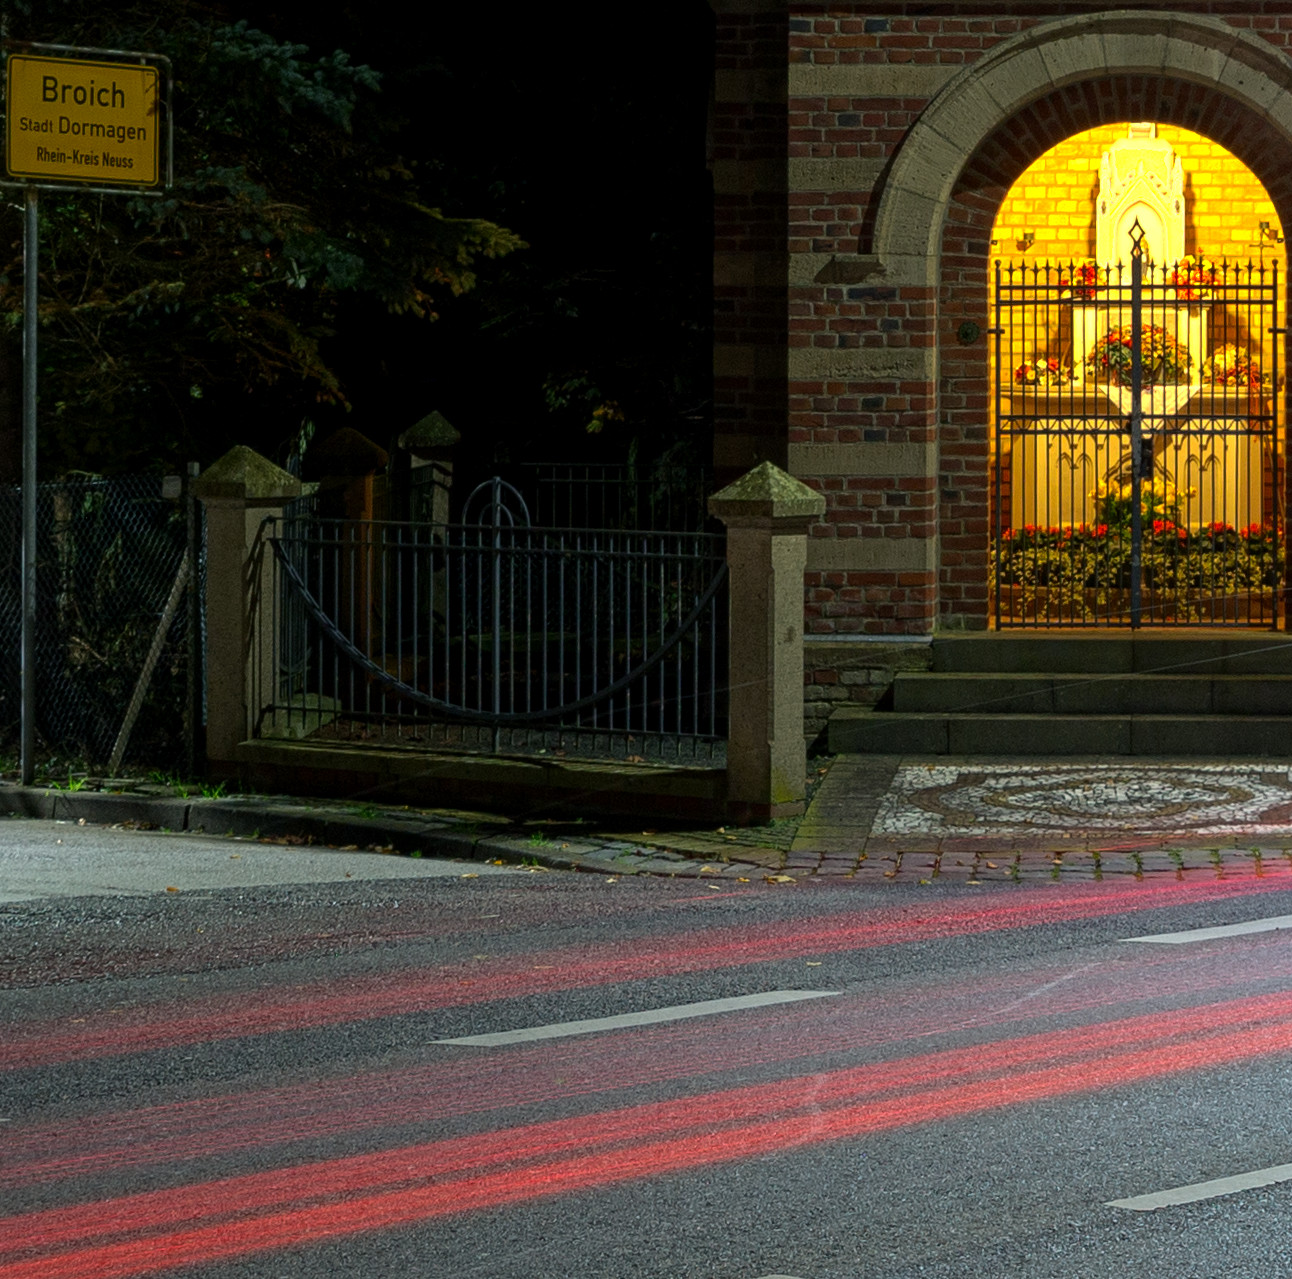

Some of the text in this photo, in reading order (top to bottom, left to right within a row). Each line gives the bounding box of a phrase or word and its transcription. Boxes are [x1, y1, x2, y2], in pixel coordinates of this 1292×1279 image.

[42, 75, 125, 109] Broich
[19, 116, 147, 143] Stadt Dormagen
[36, 146, 134, 169] Rhein-Kreis Neuss
